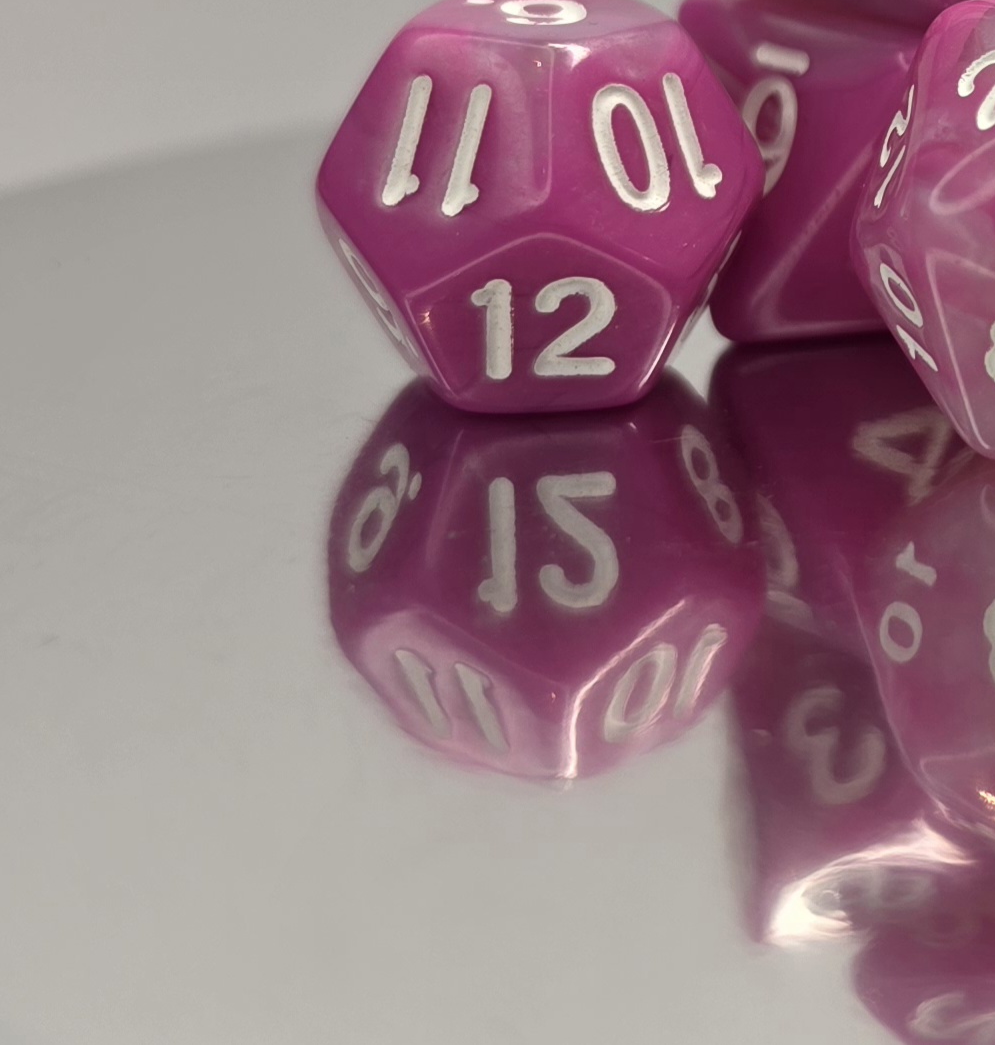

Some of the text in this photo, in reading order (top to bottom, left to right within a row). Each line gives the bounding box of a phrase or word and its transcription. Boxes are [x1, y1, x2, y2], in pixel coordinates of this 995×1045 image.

[380, 73, 494, 218] 11
[590, 70, 724, 213] 10
[470, 275, 617, 382] 12
[879, 261, 940, 373] 10
